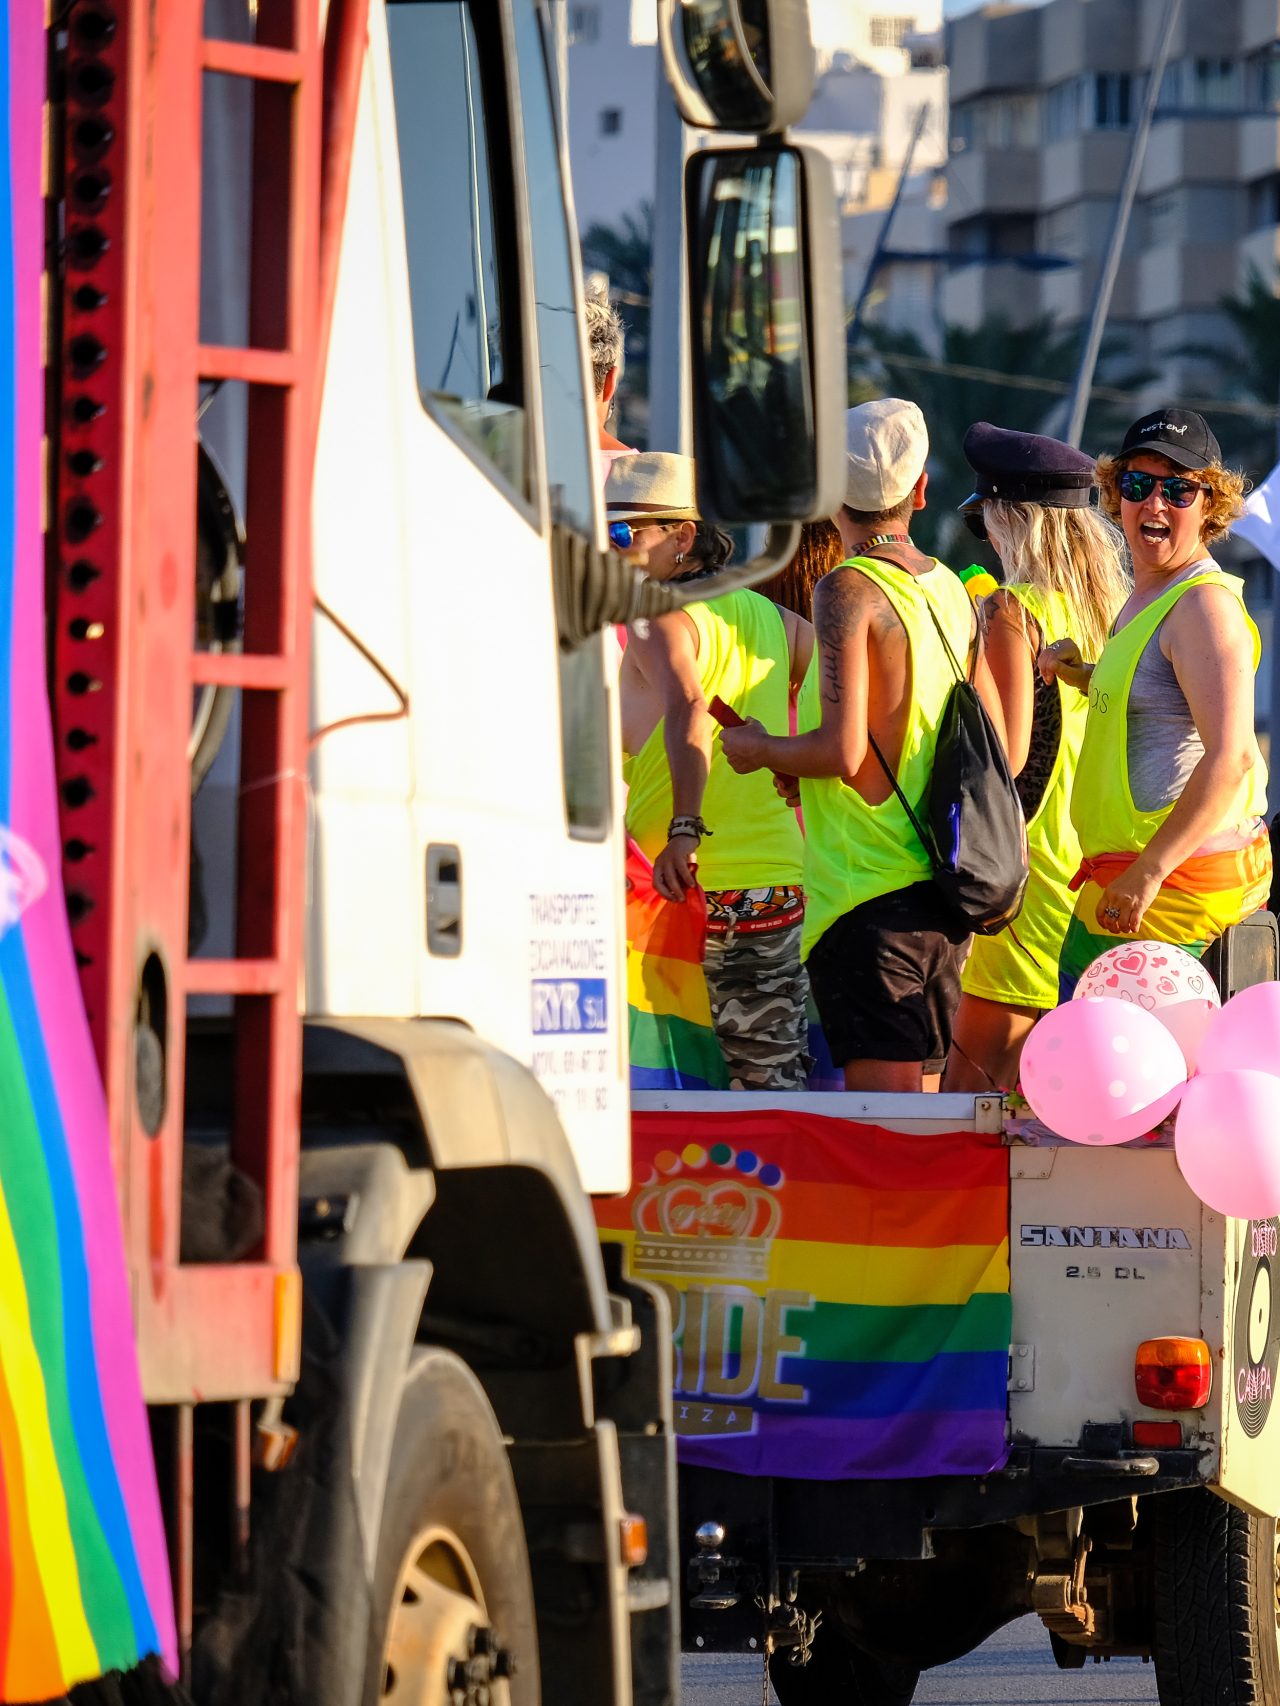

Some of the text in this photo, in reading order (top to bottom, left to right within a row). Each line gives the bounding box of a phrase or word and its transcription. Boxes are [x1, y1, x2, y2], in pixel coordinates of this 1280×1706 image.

[1020, 1224, 1192, 1250] SANTANA
[655, 1280, 816, 1404] IDE
[679, 1406, 737, 1425] IZA
